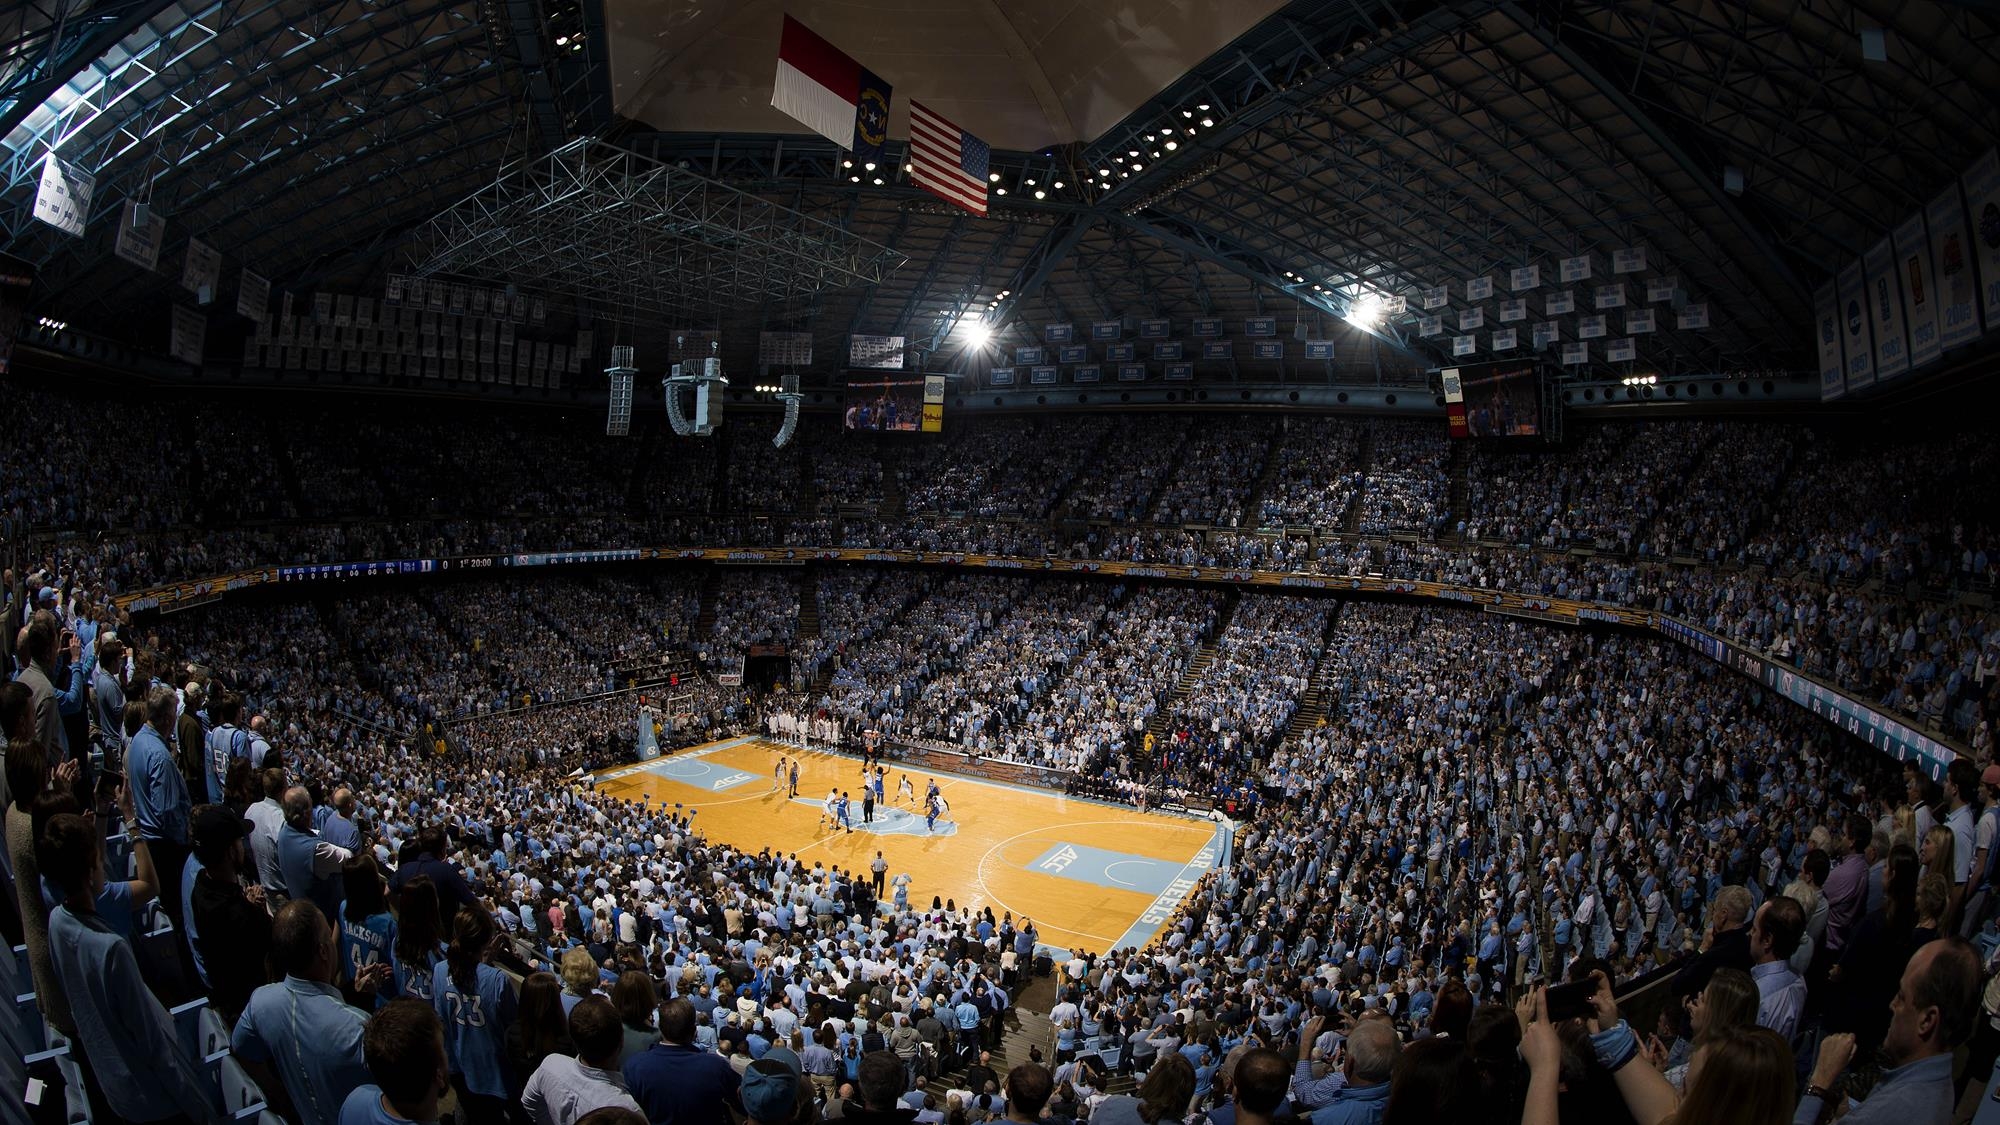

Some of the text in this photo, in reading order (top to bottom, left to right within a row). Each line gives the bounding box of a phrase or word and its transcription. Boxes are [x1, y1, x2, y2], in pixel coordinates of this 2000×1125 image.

[1945, 303, 1972, 326] 2005
[443, 560, 448, 569] 0
[471, 558, 492, 568] 20:00
[504, 557, 509, 566] 0
[728, 552, 766, 560] AROUND
[864, 553, 898, 562] AROUND
[986, 559, 1023, 569] AROUND
[1124, 568, 1168, 577] AROUND
[1280, 577, 1326, 588] AROUND
[1438, 590, 1474, 602] AROUND
[1577, 608, 1620, 624] AROUND
[1769, 667, 1775, 686] 0
[1830, 707, 1840, 724] 0-0
[1848, 716, 1859, 734] 0-0
[1869, 727, 1875, 743] 0
[1883, 736, 1889, 752] 0
[1899, 744, 1905, 761] 0
[1932, 763, 1940, 781] 0
[1884, 720, 1896, 734] AST
[1902, 727, 1910, 742] TO
[1917, 737, 1926, 753] STL
[1933, 744, 1946, 762] BLK
[713, 773, 752, 790] ACC
[1040, 845, 1078, 873] ACC
[1140, 878, 1197, 925] HEELS
[344, 919, 384, 950] JACKSON
[445, 991, 486, 1027] 23
